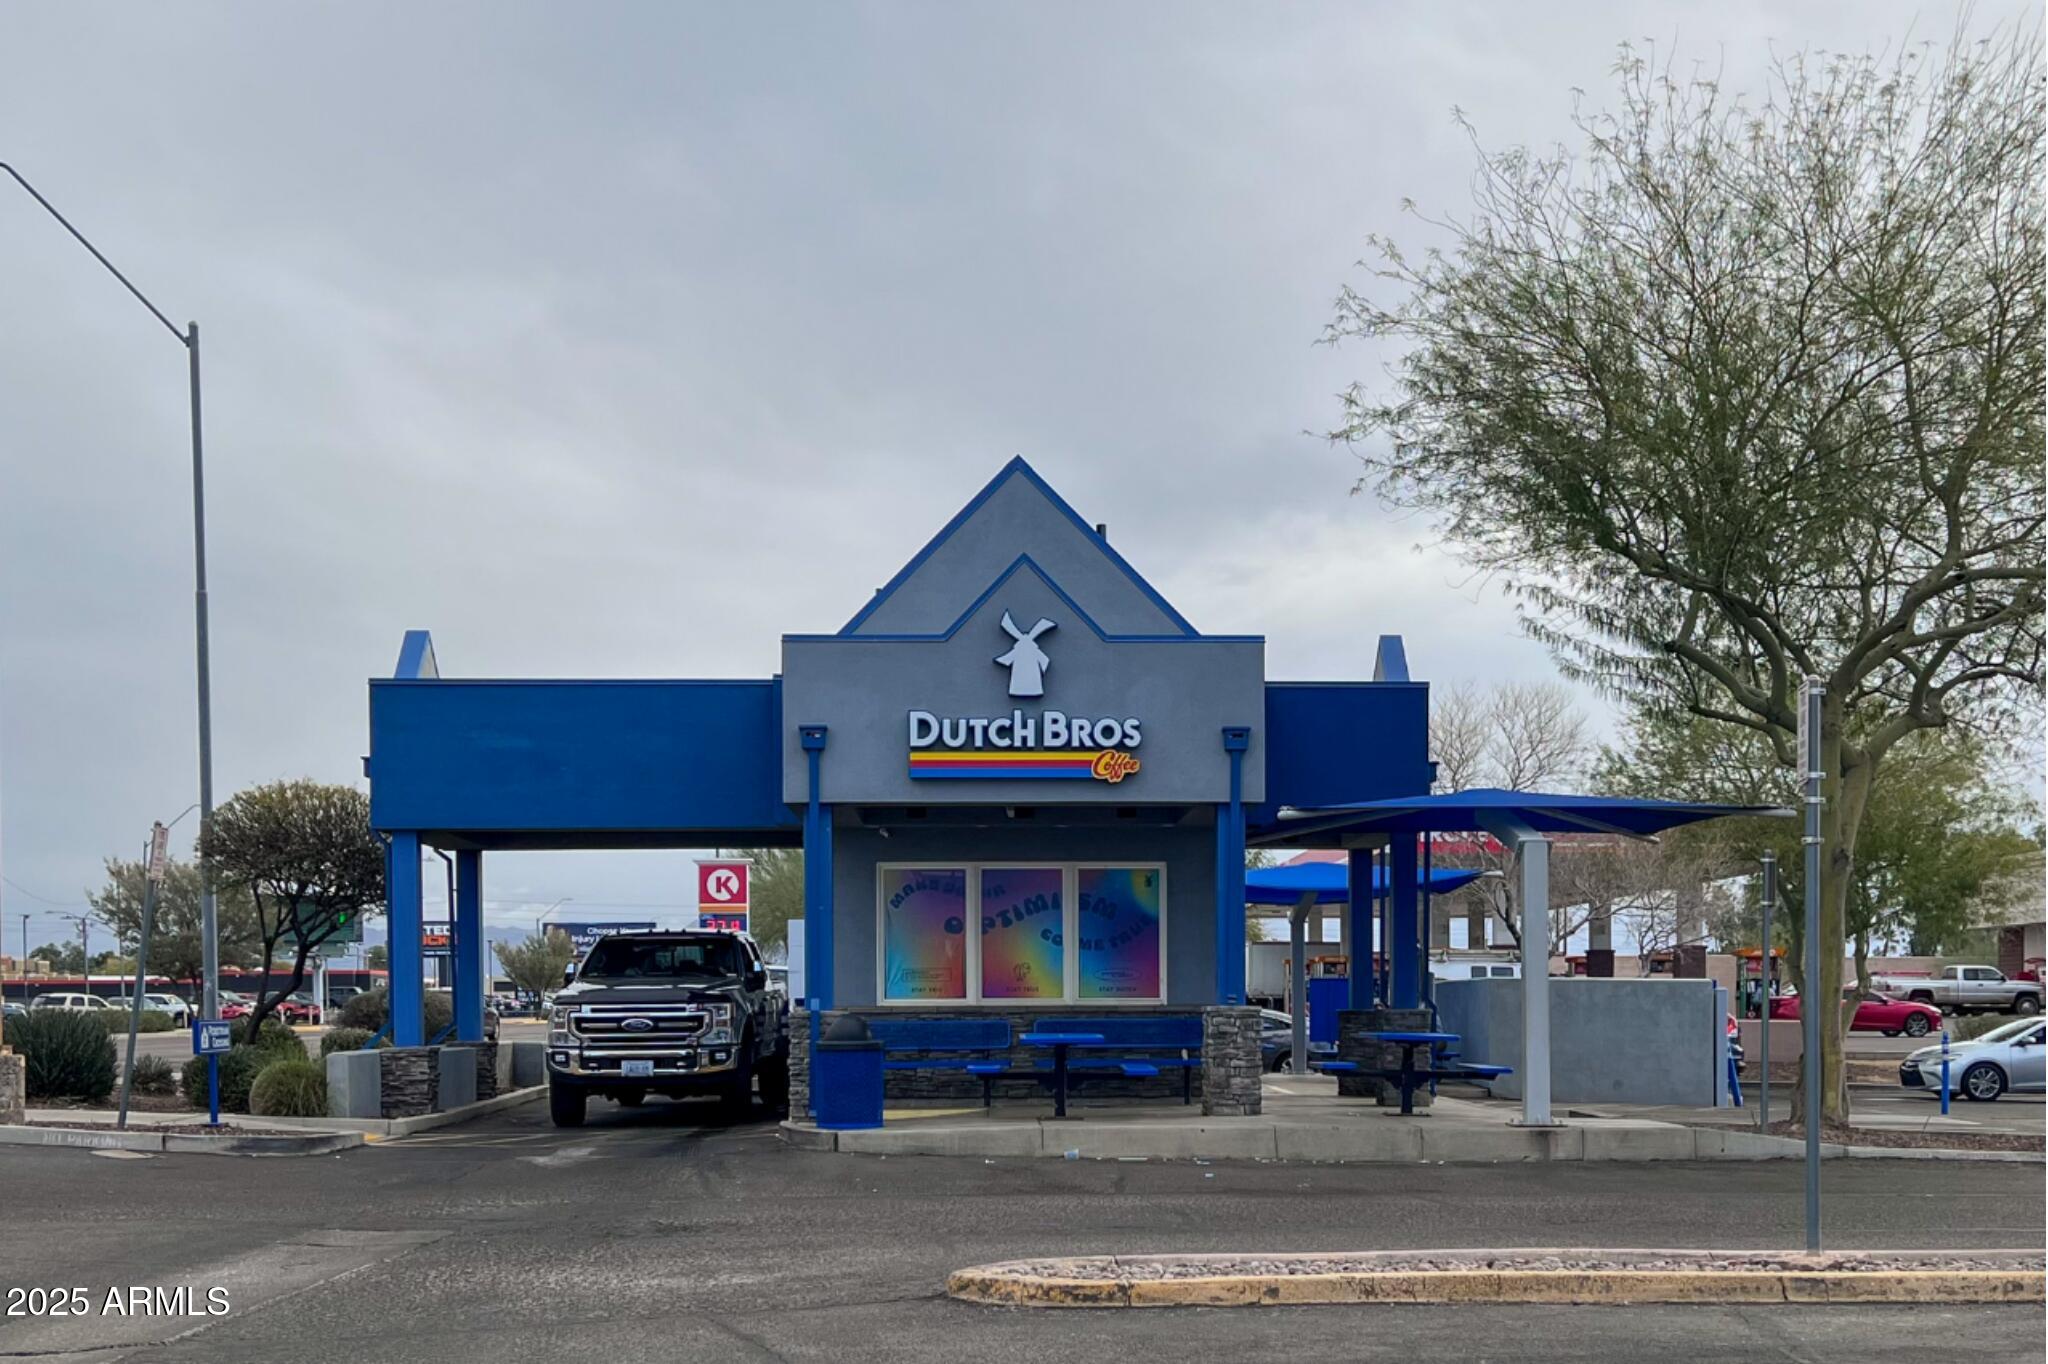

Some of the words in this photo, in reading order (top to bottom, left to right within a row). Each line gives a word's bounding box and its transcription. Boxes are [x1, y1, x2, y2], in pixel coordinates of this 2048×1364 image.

[1043, 710, 1142, 748] BROS
[1093, 750, 1141, 781] Coffee
[713, 873, 738, 899] K
[943, 891, 1118, 935] OPTIMISM
